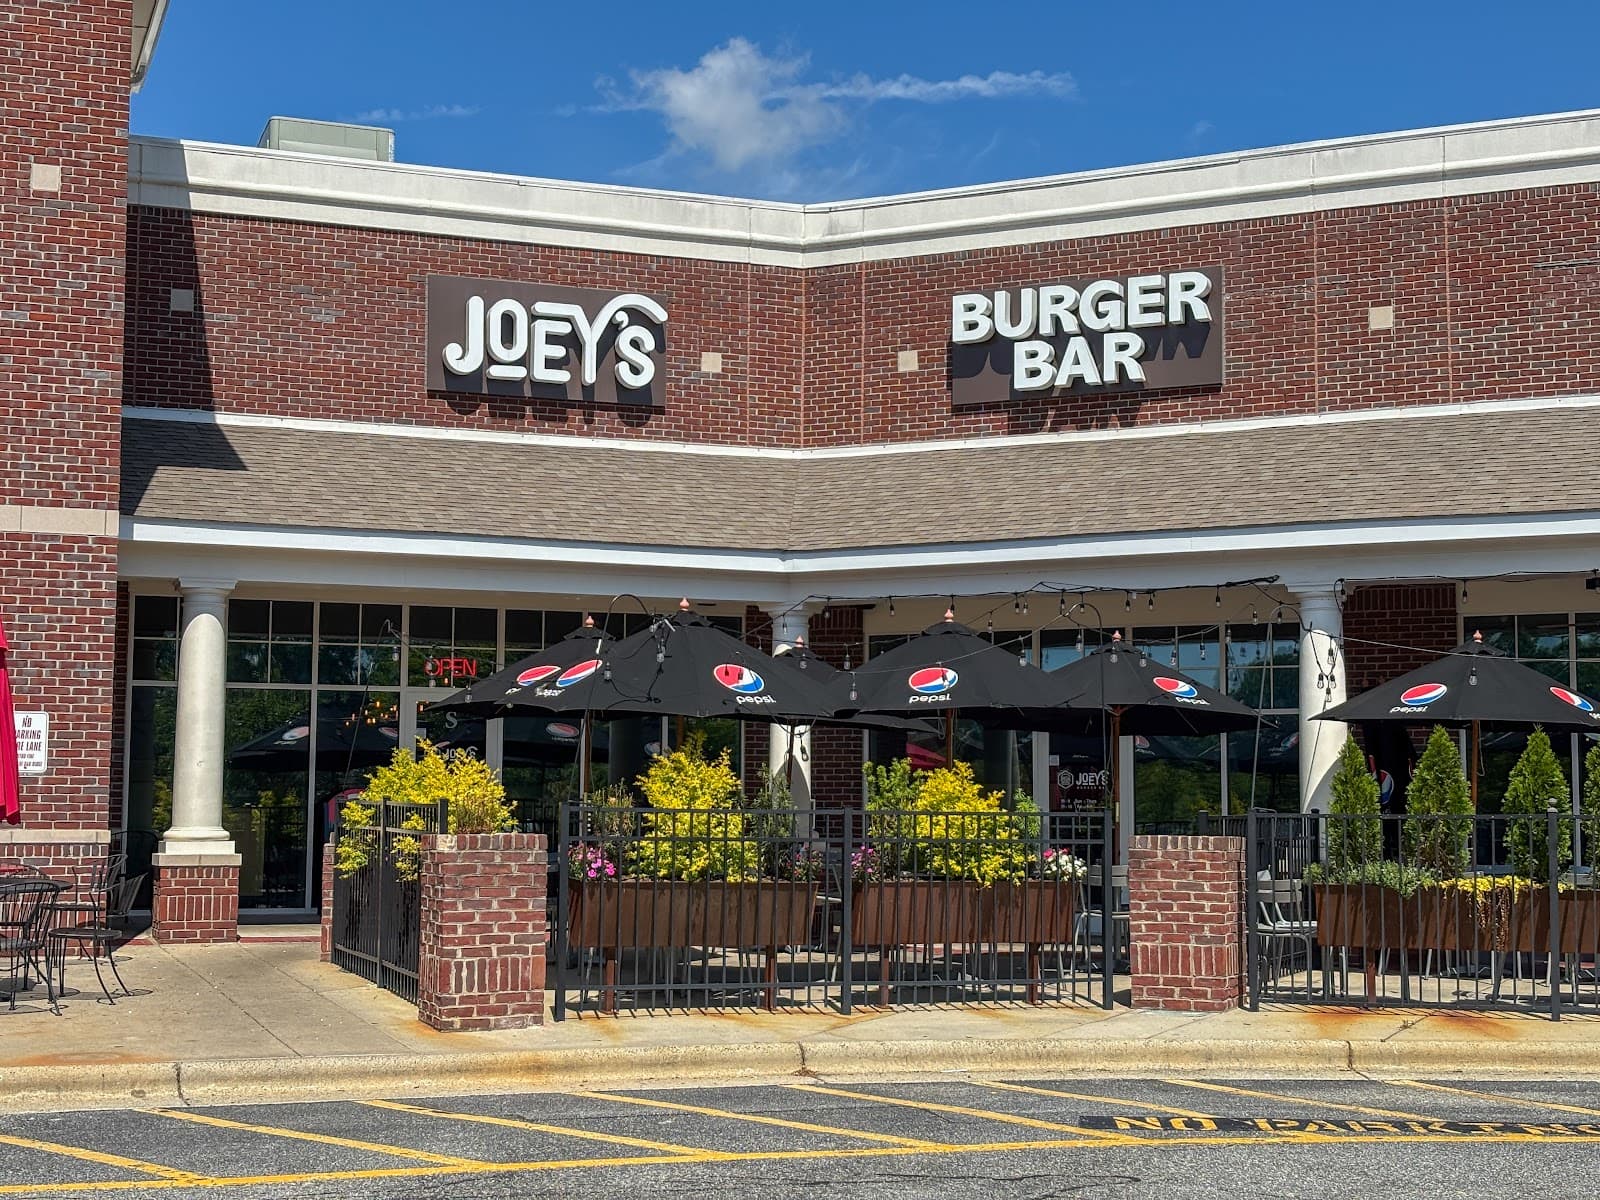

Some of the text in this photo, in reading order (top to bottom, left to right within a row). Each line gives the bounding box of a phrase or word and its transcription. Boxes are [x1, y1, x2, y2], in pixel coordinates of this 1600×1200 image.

[952, 271, 1213, 345] BURGER
[442, 293, 669, 389] JOEY'S
[1013, 332, 1146, 391] BAR
[424, 658, 477, 677] OPEN
[735, 695, 777, 704] pepsi
[908, 693, 952, 704] pepsi
[1389, 705, 1428, 713] pepsi
[22, 717, 32, 728] NO
[16, 729, 42, 740] ARKING
[26, 741, 42, 752] LANE
[1112, 1116, 1218, 1131] NO
